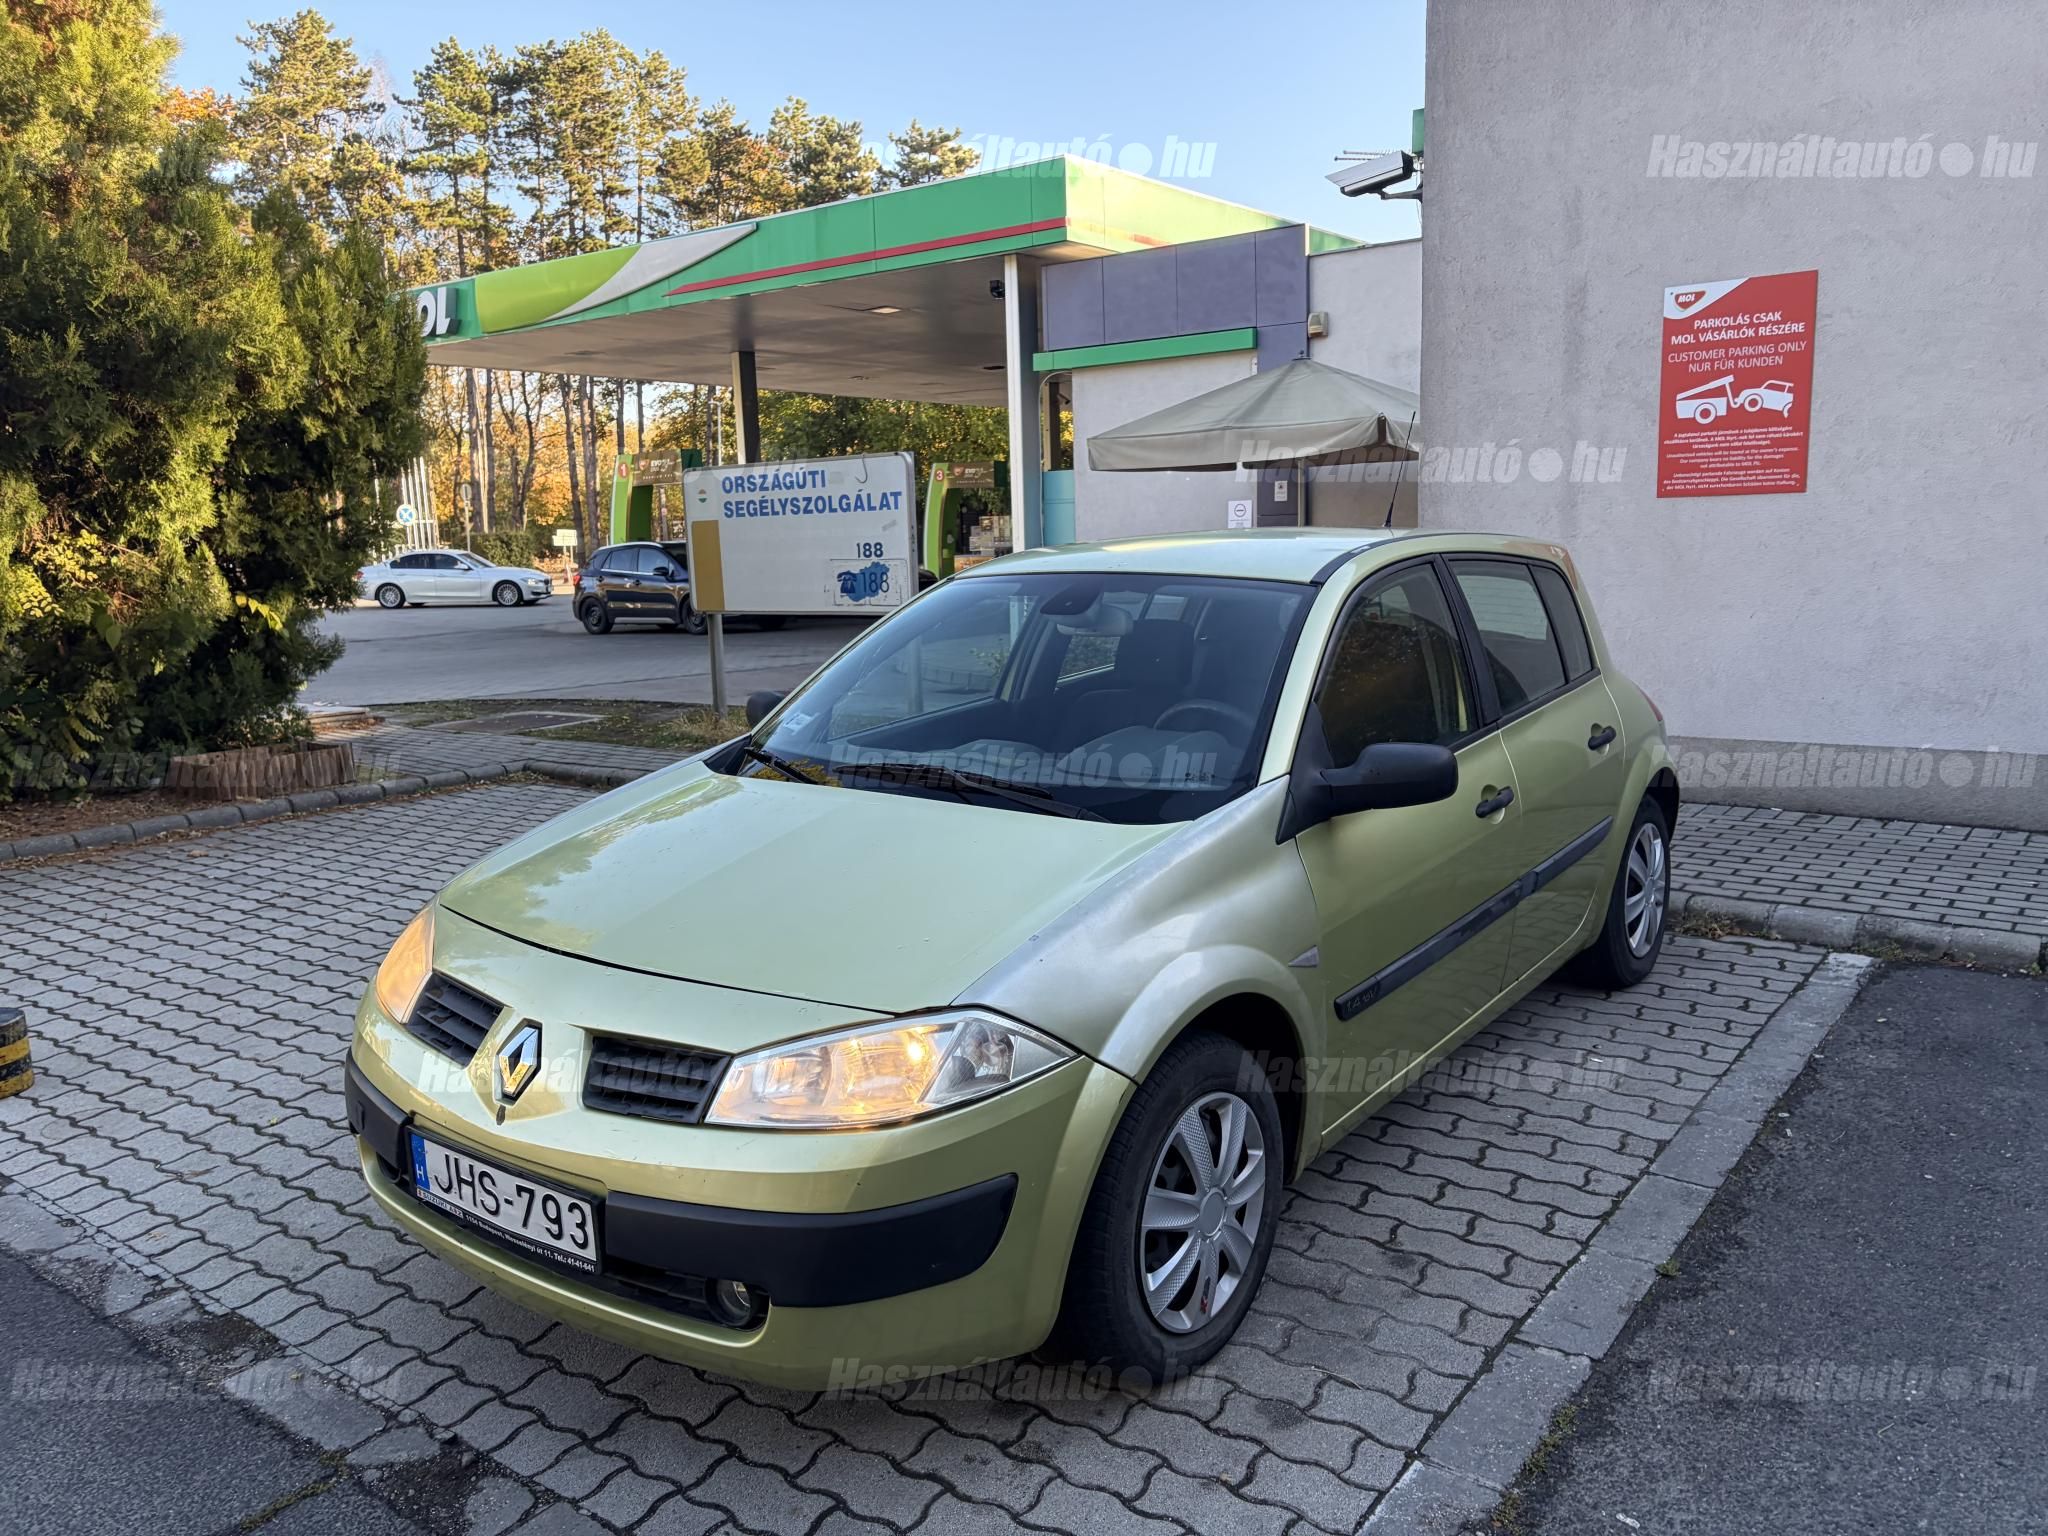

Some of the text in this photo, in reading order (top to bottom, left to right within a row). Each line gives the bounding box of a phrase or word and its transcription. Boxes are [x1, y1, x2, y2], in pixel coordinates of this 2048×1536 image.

[1678, 293, 1696, 303] MOL
[416, 287, 448, 338] OL
[1694, 311, 1782, 329] PARKOLÁS CSAK
[1671, 322, 1806, 345] MOL VÁSÁRLÓK RÉSZÉRE
[1668, 341, 1807, 363] CUSTOMER PARKING ONLY
[1688, 355, 1783, 373] NUR FÜR KUNDEN
[620, 463, 626, 477] 1
[722, 467, 826, 494] ORSZÁGÚTI
[936, 470, 943, 480] 3
[723, 488, 902, 518] SEGÉLYSZOLGÁLAT
[856, 542, 884, 558] 188
[860, 572, 890, 593] 188
[416, 1153, 588, 1250] H JHS-793
